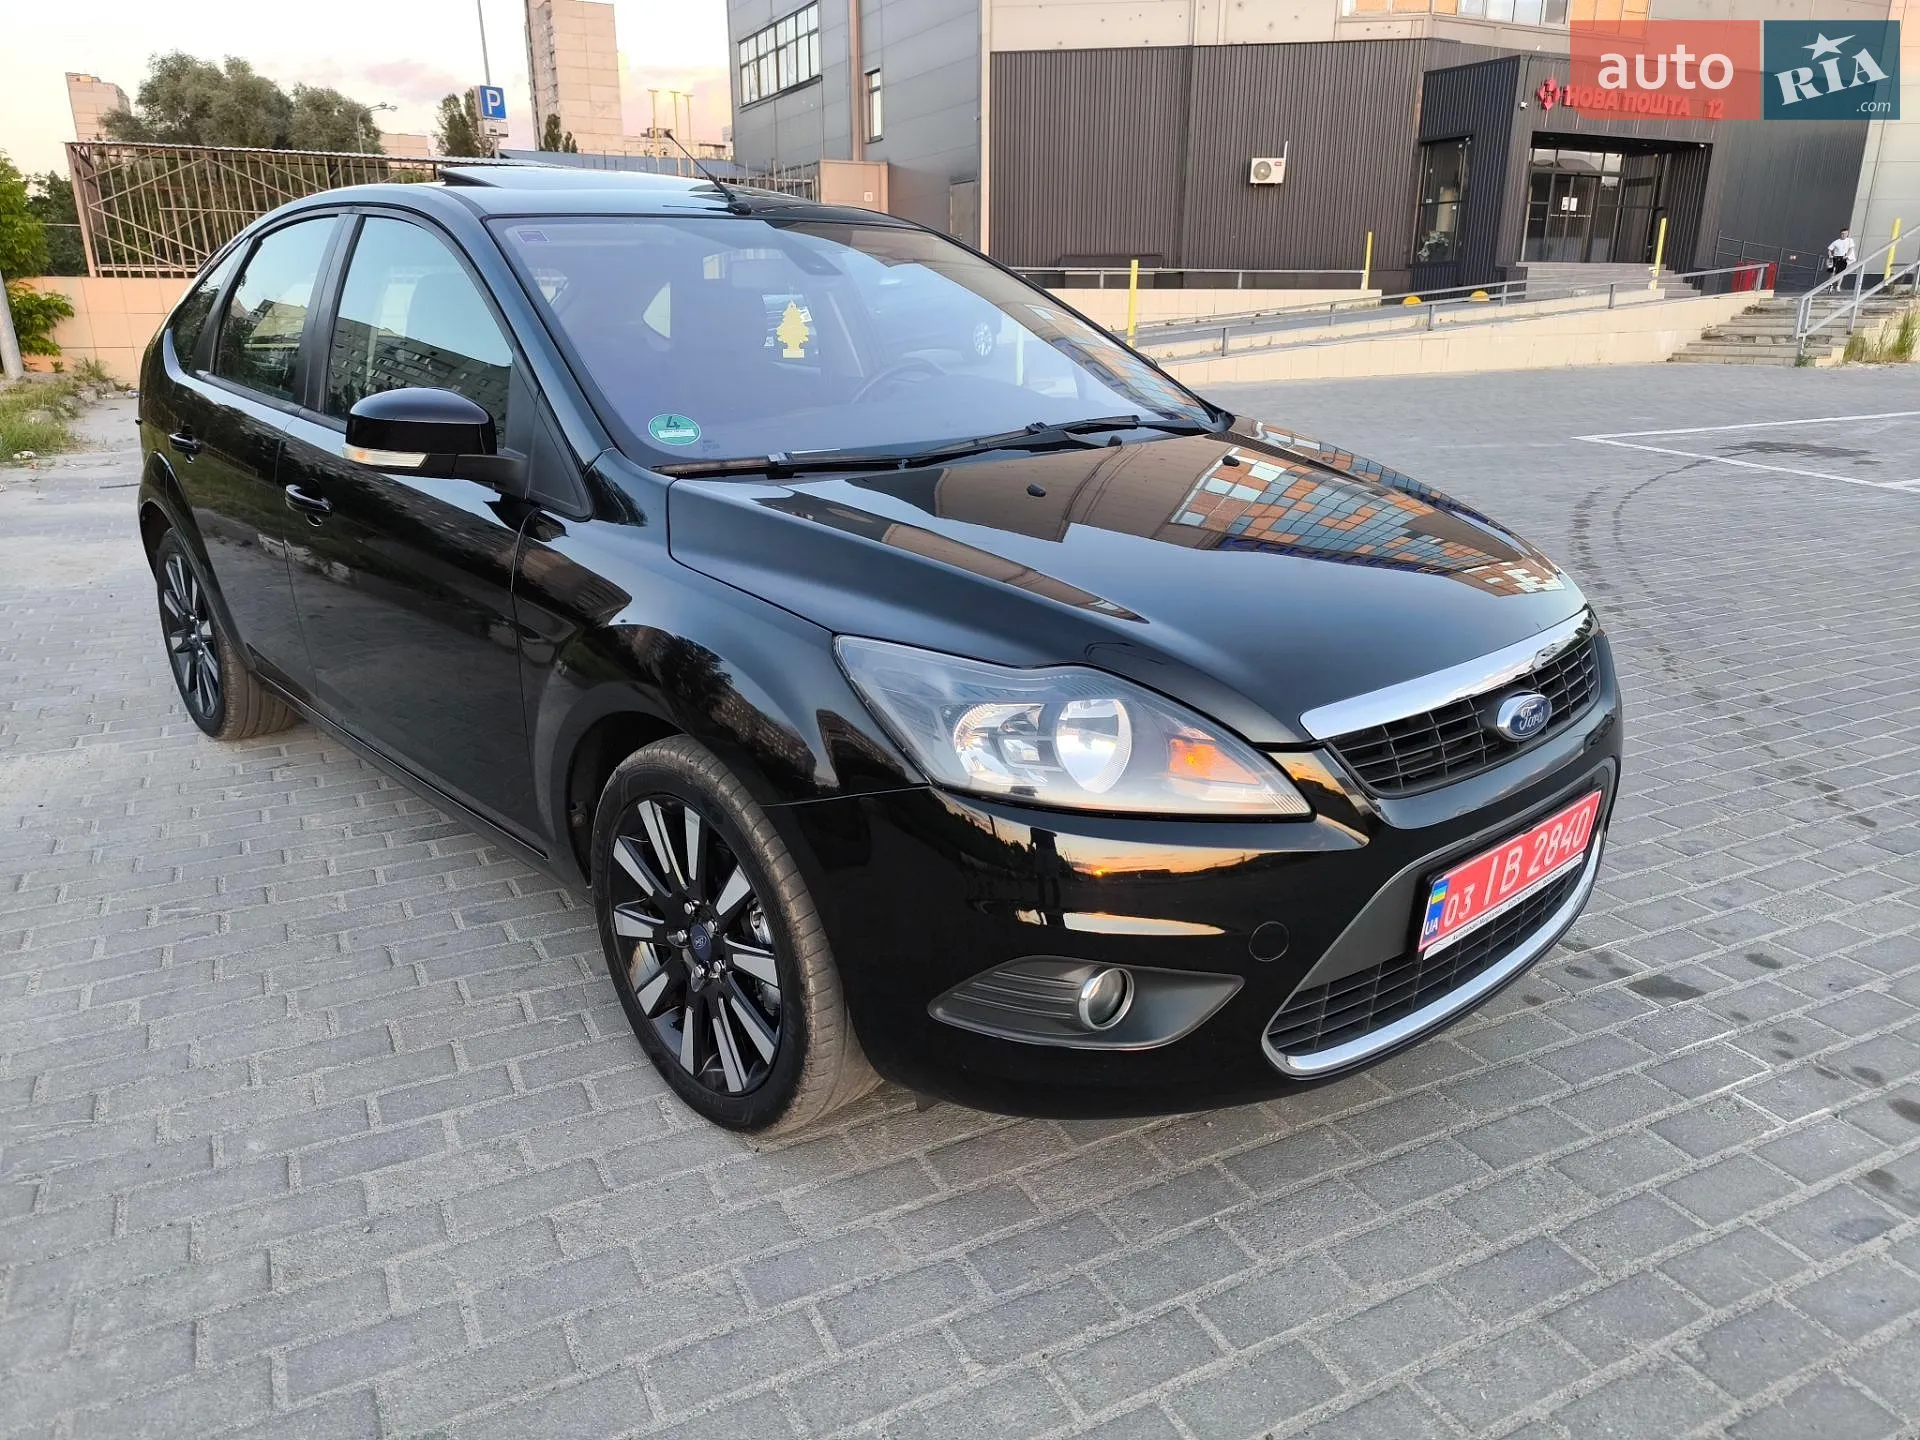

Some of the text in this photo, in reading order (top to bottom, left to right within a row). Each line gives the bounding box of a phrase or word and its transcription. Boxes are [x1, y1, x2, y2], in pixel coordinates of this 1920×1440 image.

[486, 89, 501, 115] P
[1563, 84, 1724, 119] НОВА ПОШТА 12
[666, 416, 680, 429] 4
[1519, 703, 1544, 731] Ford
[1443, 882, 1476, 928] 03
[1526, 805, 1591, 878] 2840
[1425, 919, 1438, 936] UA
